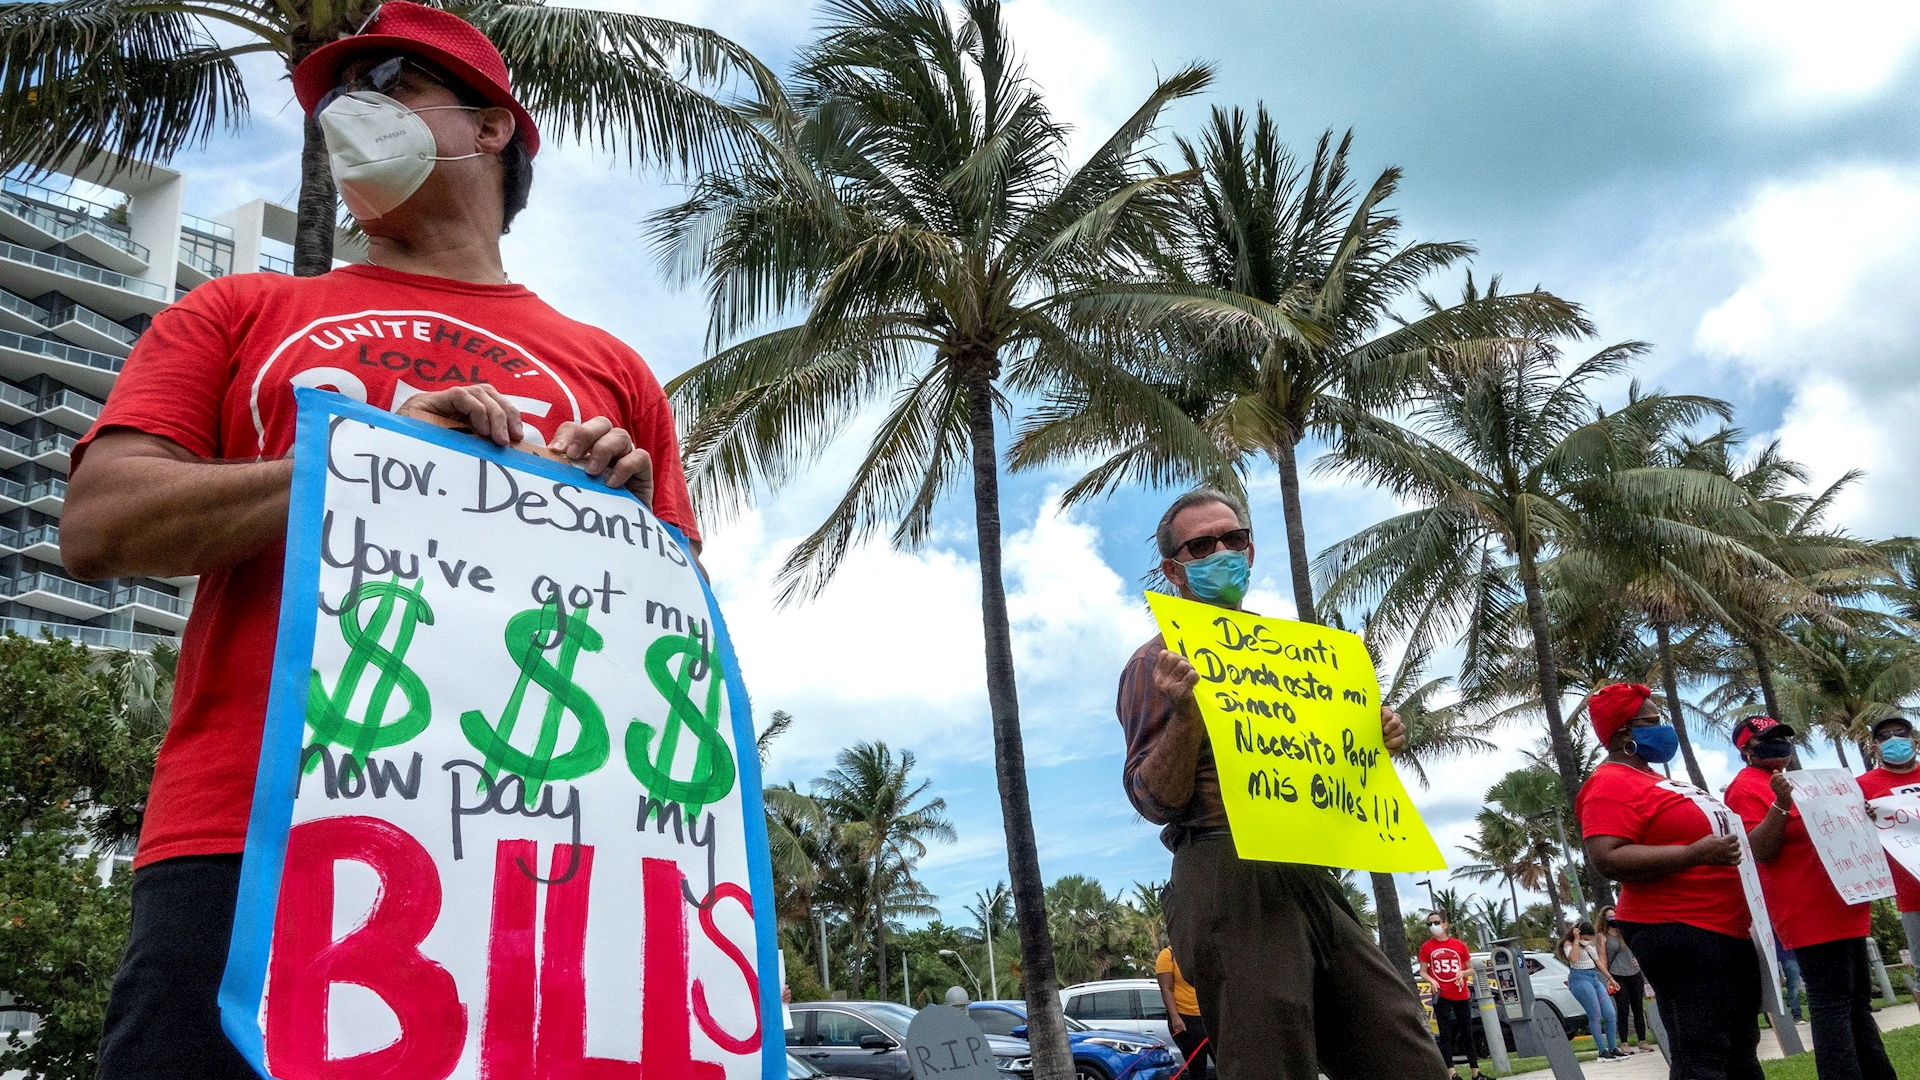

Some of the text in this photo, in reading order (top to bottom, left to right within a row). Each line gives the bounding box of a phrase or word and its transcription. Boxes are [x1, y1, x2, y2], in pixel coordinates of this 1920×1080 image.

[358, 344, 490, 384] LOCAL
[326, 415, 690, 567] Gov. DeSantis
[318, 511, 709, 681] You've got my
[1212, 616, 1338, 670] DeSanti
[1215, 690, 1297, 724] Dinero
[1343, 688, 1367, 708] mi
[1234, 717, 1336, 765] Necesito
[441, 759, 580, 884] pay
[636, 794, 717, 911] my
[262, 815, 762, 1080] BILLS
[1433, 959, 1460, 974] 355
[915, 1036, 989, 1076] R.I.P.
